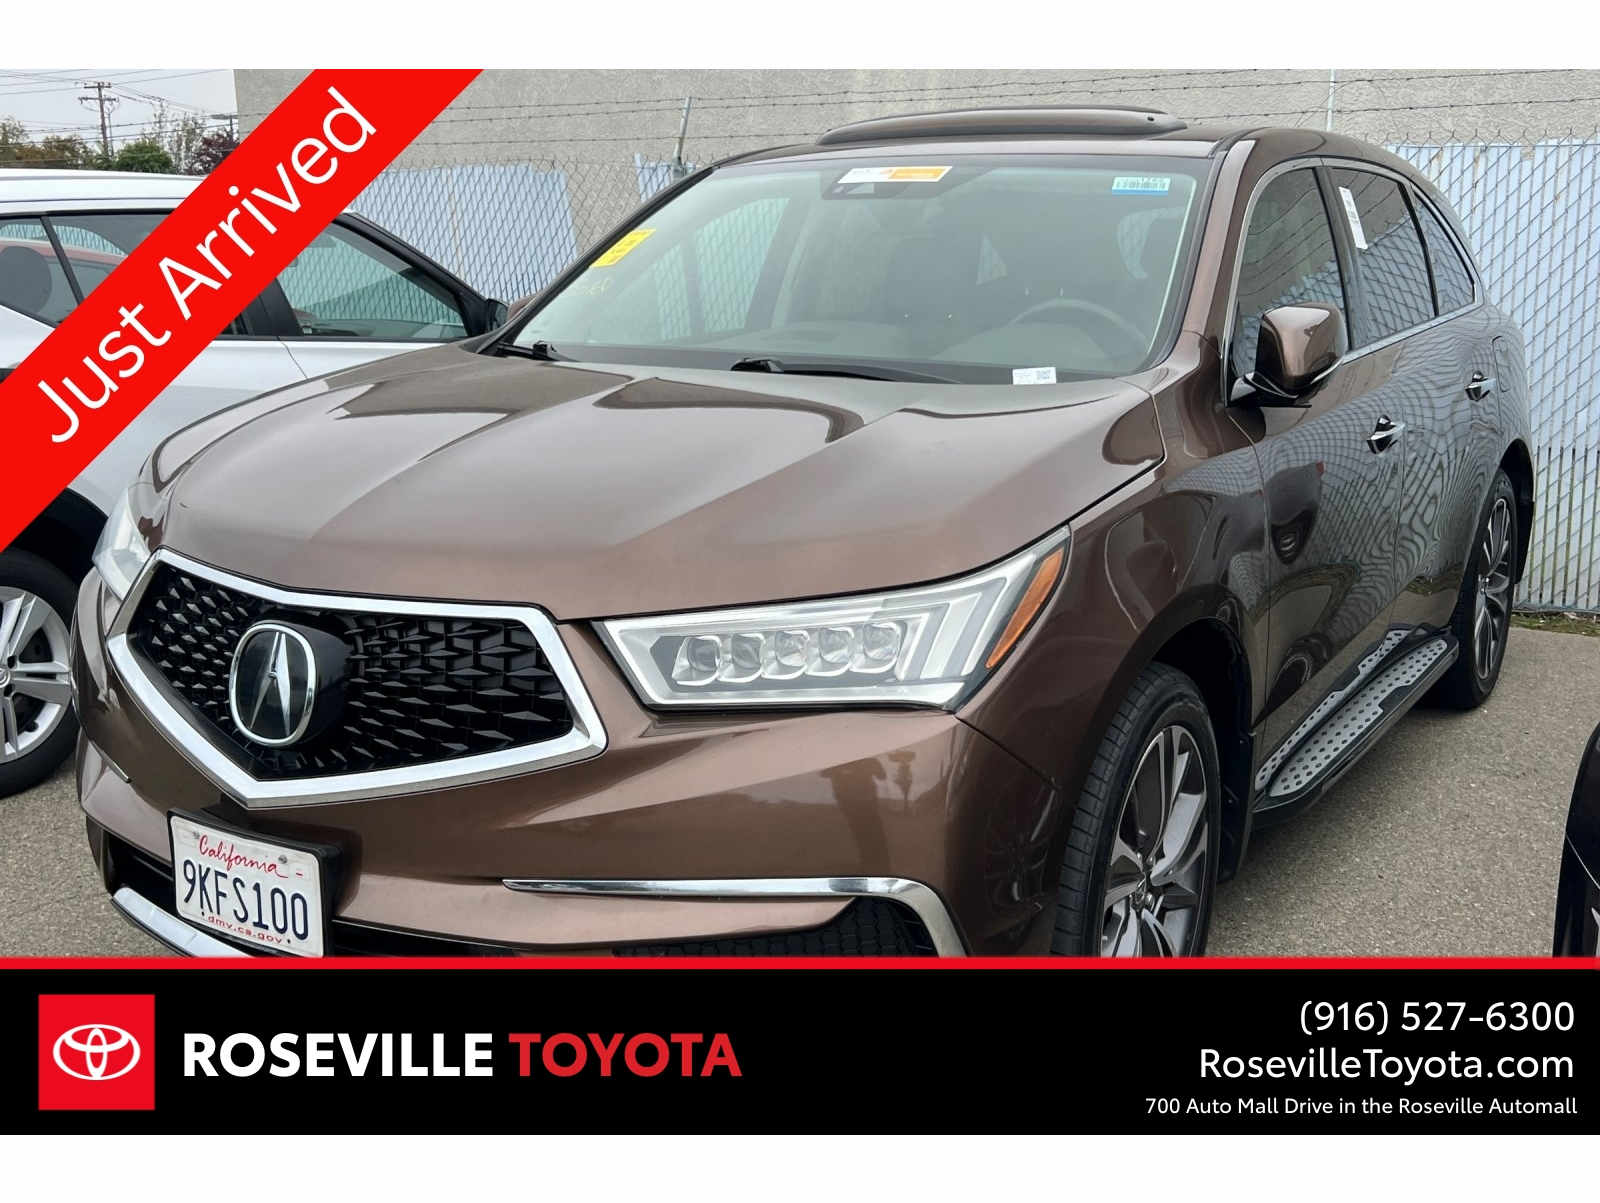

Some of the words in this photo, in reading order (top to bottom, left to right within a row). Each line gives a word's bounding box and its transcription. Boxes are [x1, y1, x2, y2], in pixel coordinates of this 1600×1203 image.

[198, 834, 289, 879] California
[183, 858, 309, 941] 9KFS100
[207, 914, 283, 945] dmv.ca.gov
